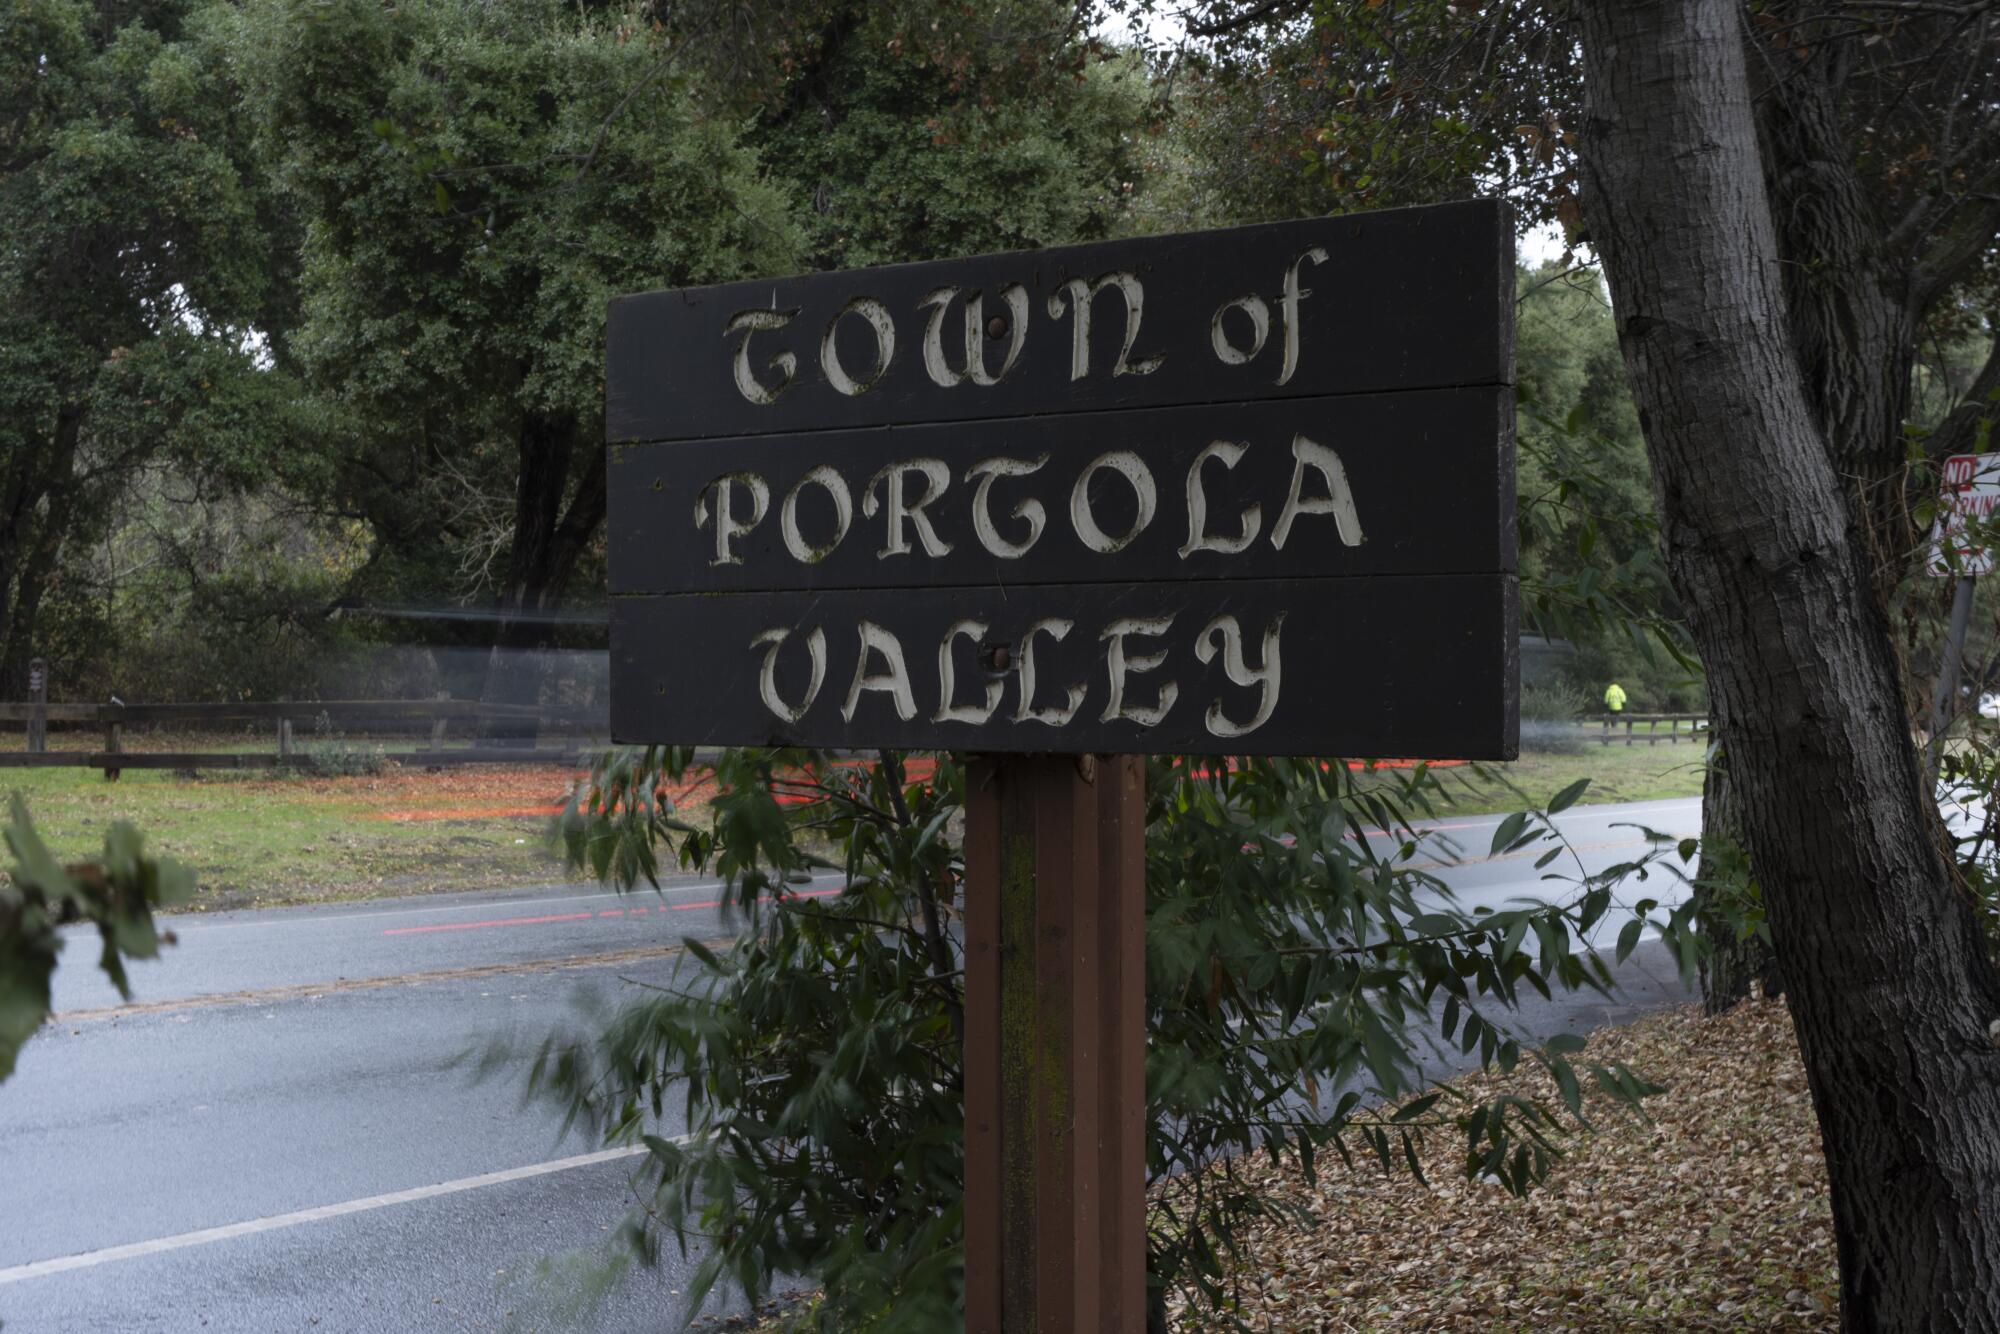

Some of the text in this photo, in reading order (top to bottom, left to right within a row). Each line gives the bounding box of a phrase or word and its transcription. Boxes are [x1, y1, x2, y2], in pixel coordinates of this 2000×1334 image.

[724, 247, 1330, 404] TOWN of
[694, 434, 1367, 567] PORTOLA
[1946, 461, 1971, 487] NO
[750, 610, 1288, 737] VALLEY
